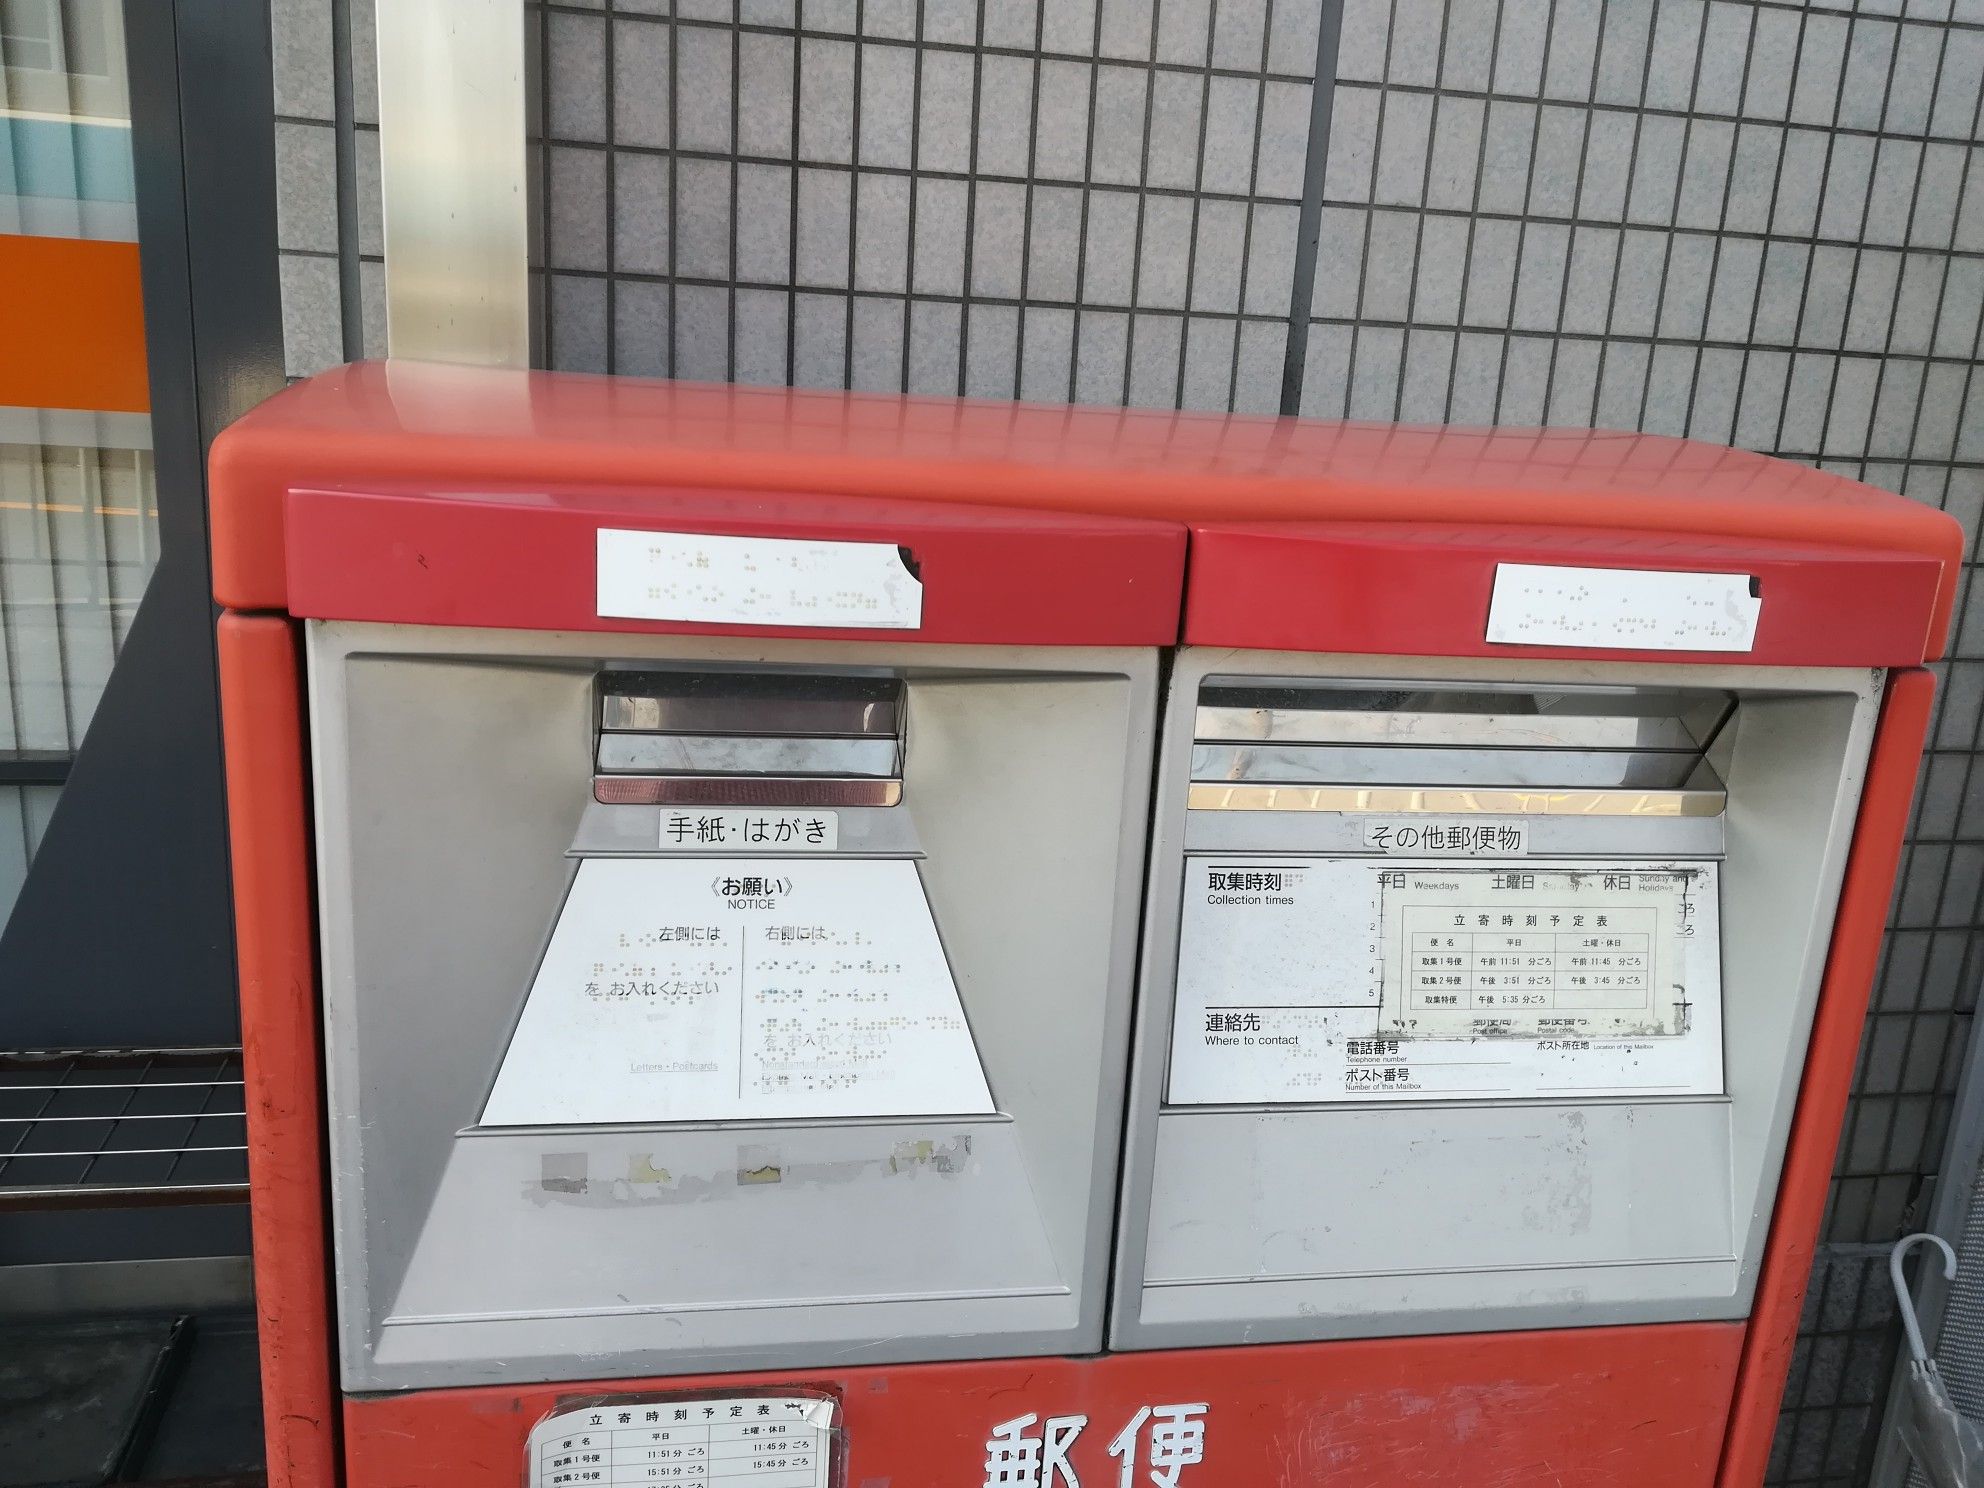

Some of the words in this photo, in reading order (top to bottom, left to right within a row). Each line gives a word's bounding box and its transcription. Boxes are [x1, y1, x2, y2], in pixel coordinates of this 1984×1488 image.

[1371, 825, 1522, 850] その他郵便物
[1208, 873, 1282, 892] 取集時刻
[1377, 873, 1406, 889] 平日
[1414, 881, 1460, 891] Weekdays
[1491, 875, 1535, 890] 土曜日
[1603, 875, 1631, 891] 休日
[727, 899, 775, 910] NOTICE
[1207, 894, 1261, 905] Collection
[1265, 894, 1294, 905] times
[1370, 900, 1376, 908] 1
[1369, 923, 1376, 931] 2
[658, 926, 721, 941] 左側には
[1506, 938, 1522, 947] 平日
[1480, 957, 1496, 966] 午前
[1500, 957, 1520, 966] 11:51
[1571, 957, 1587, 966] 午前
[1591, 957, 1611, 966] 11:45
[1368, 967, 1375, 975] 4
[1480, 976, 1496, 985] 午後
[1503, 976, 1520, 985] 3:51
[1571, 976, 1587, 985] 午後
[1594, 976, 1610, 985] 3:45
[1368, 989, 1374, 997] 5
[1478, 995, 1494, 1004] 午後
[1502, 995, 1519, 1004] 5:35
[1205, 1013, 1261, 1032] 連絡先
[1205, 1036, 1240, 1046] Where
[1244, 1036, 1254, 1046] to
[1258, 1035, 1298, 1046] contact
[1537, 1040, 1590, 1050] ポスト所在地
[1347, 1040, 1399, 1055] 電話番号
[1346, 1067, 1410, 1082] ポスト番号
[1345, 1083, 1370, 1091] Number
[651, 1432, 670, 1440] 平日
